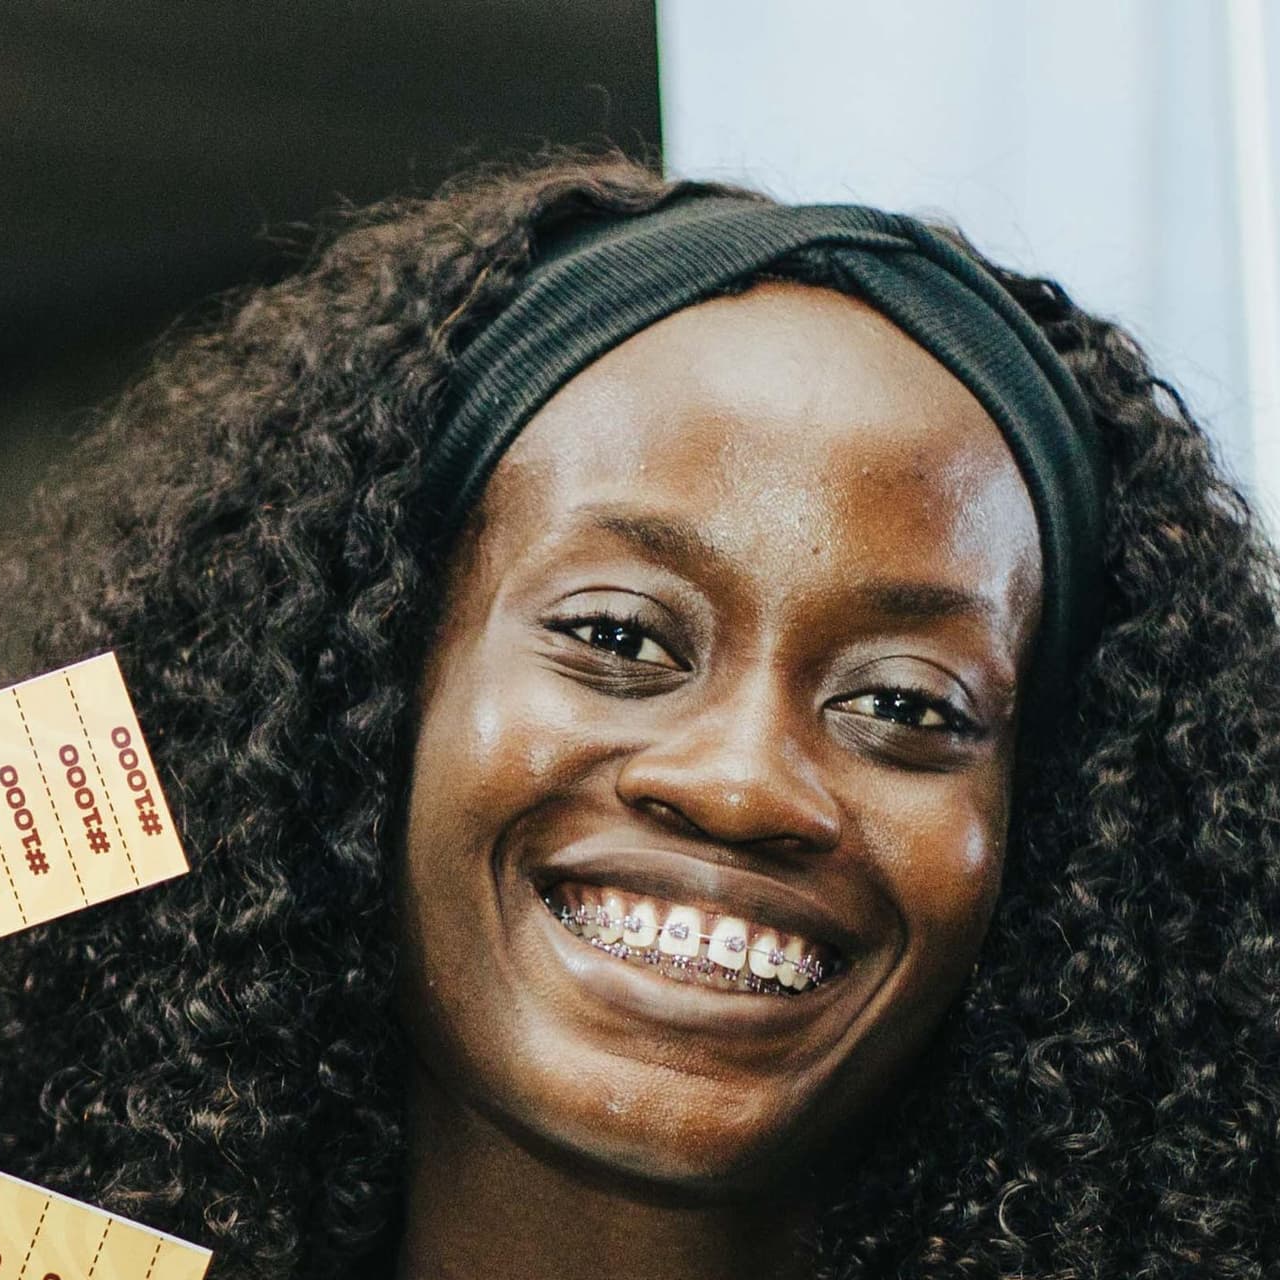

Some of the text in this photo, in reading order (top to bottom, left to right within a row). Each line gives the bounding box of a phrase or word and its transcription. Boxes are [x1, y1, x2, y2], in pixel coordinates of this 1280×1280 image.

[0, 765, 50, 876] #1000
[59, 744, 111, 855] #1000
[111, 726, 162, 837] #1000
